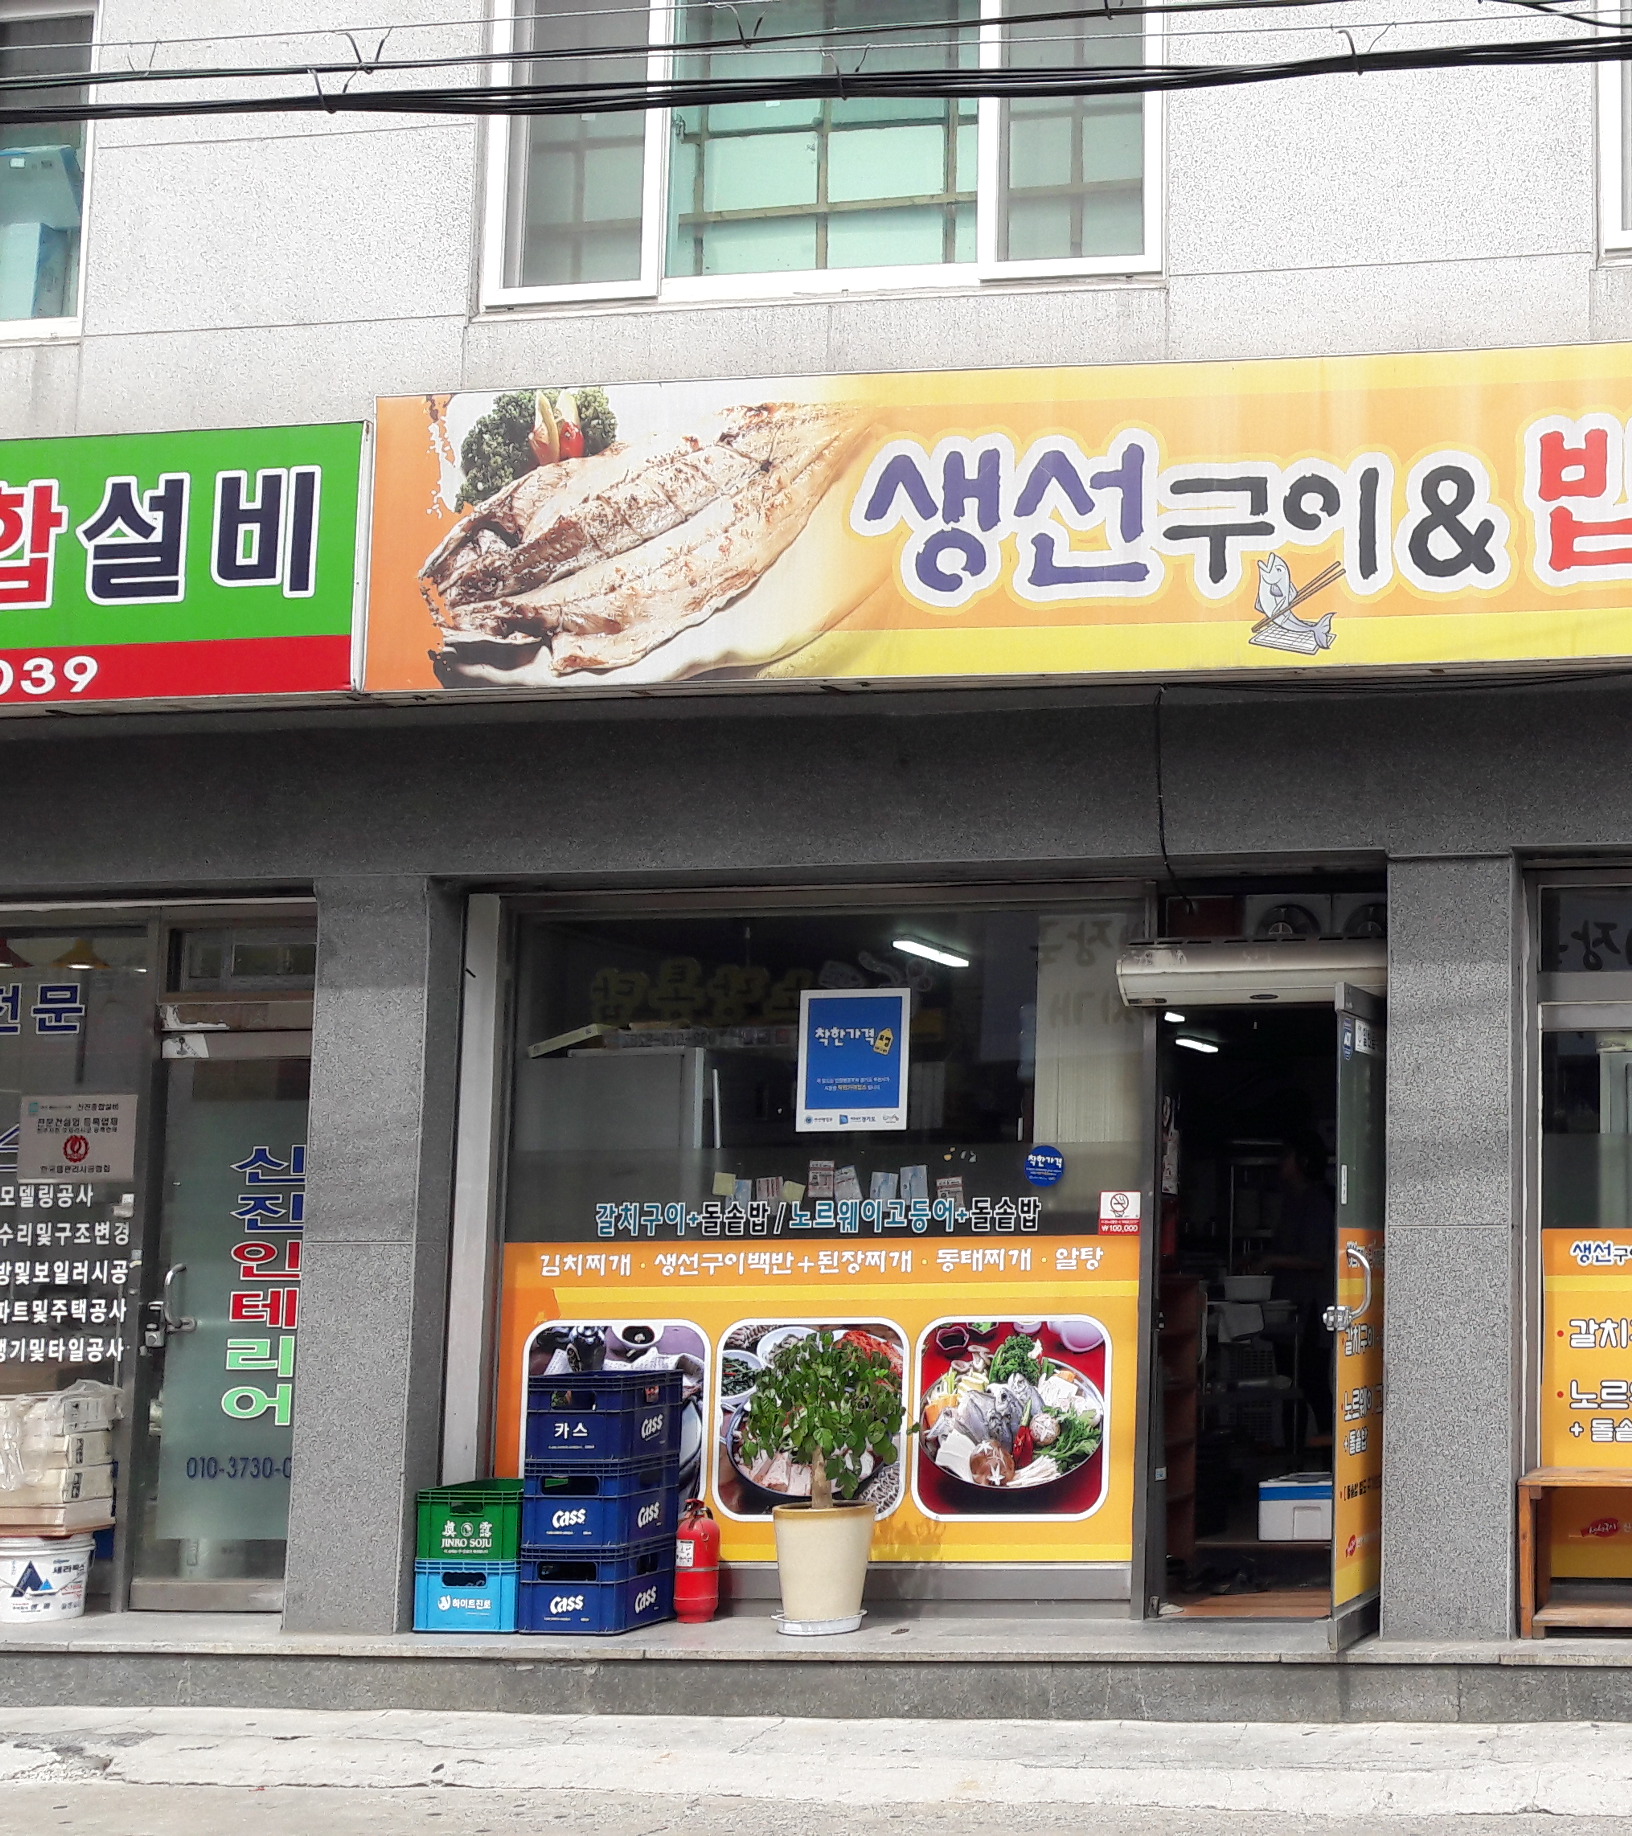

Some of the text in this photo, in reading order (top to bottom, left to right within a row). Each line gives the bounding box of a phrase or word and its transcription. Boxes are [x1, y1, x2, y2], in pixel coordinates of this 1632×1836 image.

[814, 1026, 875, 1047] 착한가격
[1028, 1154, 1063, 1168] 착한가격
[540, 1253, 632, 1277] 김치찌개
[937, 1247, 1033, 1273] 동태찌개
[1054, 1247, 1105, 1272] 알탕
[554, 1422, 588, 1440] 카스
[641, 1414, 664, 1439] Cass
[552, 1508, 586, 1529] Cass
[637, 1501, 660, 1529] Cass
[441, 1538, 492, 1548] JINRO SOJU
[550, 1595, 584, 1615] Cass
[635, 1586, 657, 1614] Cass
